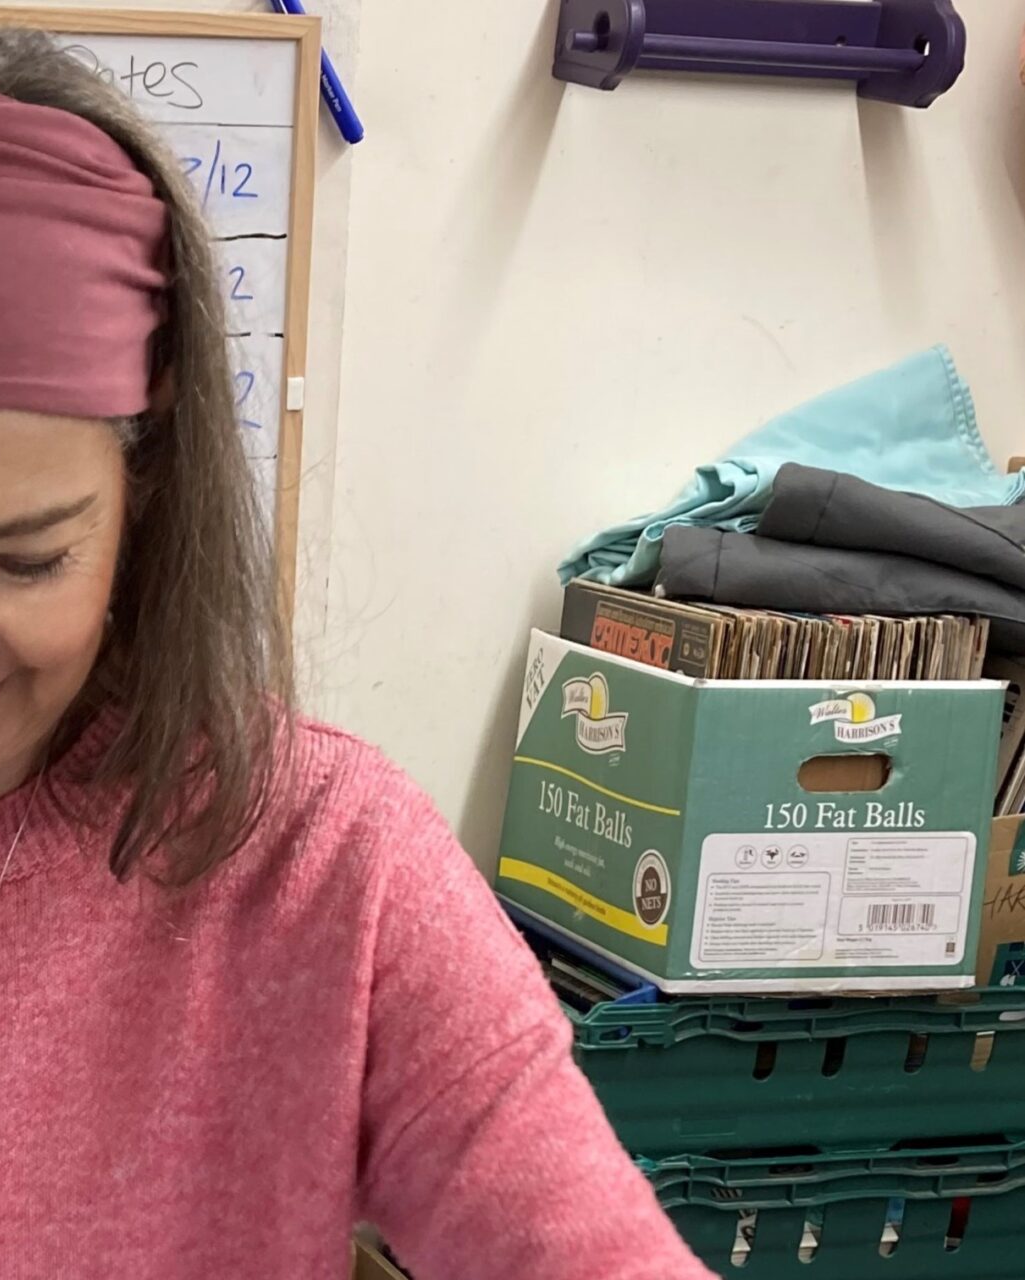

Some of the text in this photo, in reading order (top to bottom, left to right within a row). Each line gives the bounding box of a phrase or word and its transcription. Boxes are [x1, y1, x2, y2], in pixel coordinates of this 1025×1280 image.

[526, 668, 545, 710] VAT
[578, 721, 621, 743] HARRISON'S
[836, 720, 896, 740] HARRISON'S
[538, 780, 633, 848] 150 Fat Balls
[763, 801, 926, 829] 150 Fat Balls
[644, 878, 658, 893] NO
[640, 896, 662, 912] NETS
